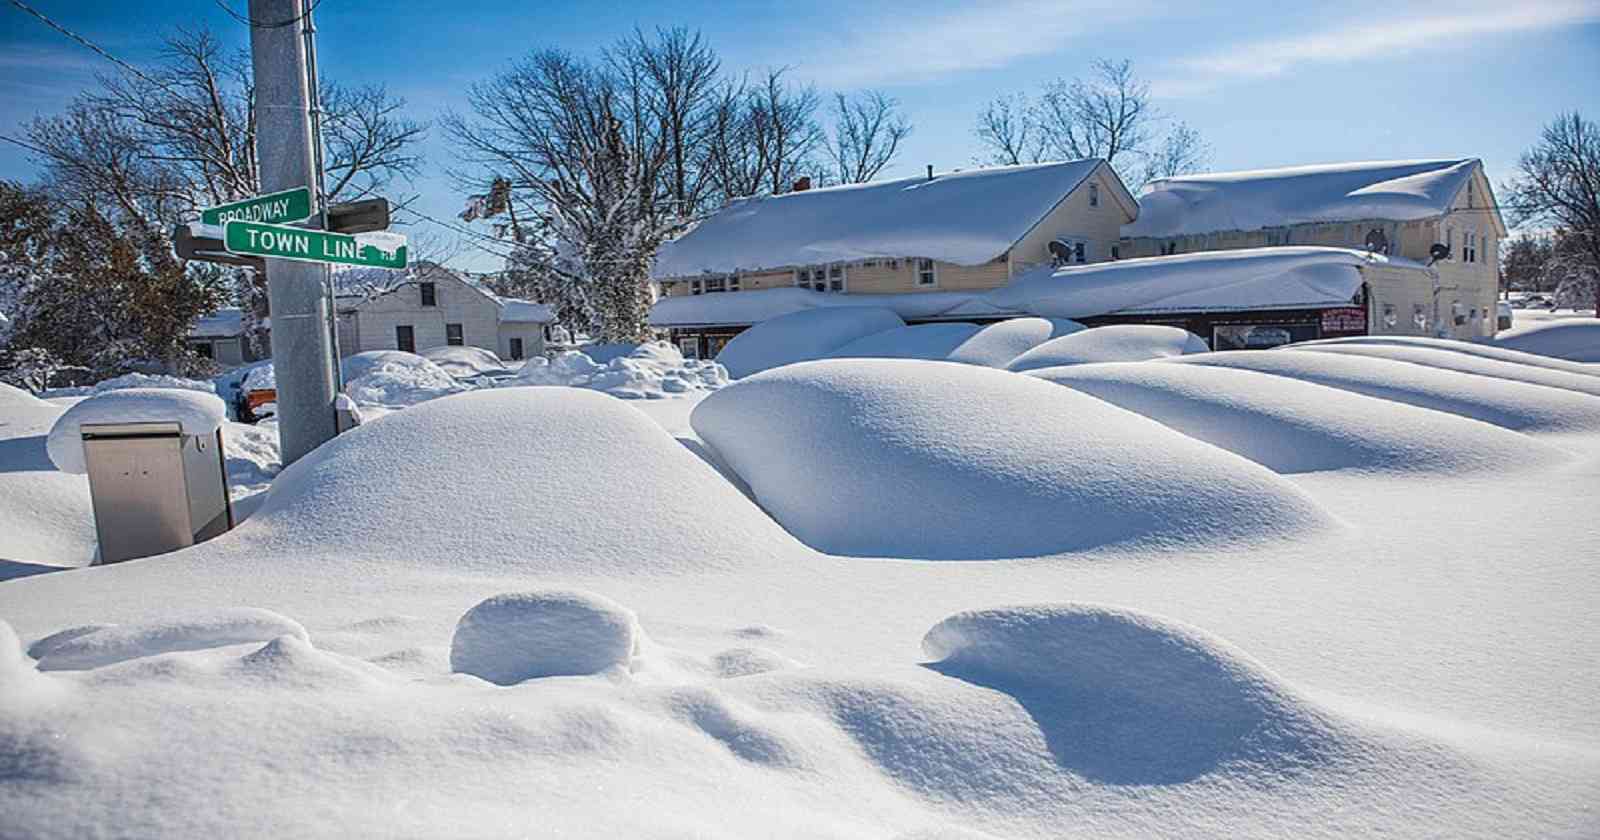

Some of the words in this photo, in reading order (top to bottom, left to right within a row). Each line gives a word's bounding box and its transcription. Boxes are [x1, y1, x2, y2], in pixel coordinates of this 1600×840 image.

[218, 199, 289, 225] BROADWAY
[246, 228, 309, 254] TOWN
[323, 239, 368, 260] LINE
